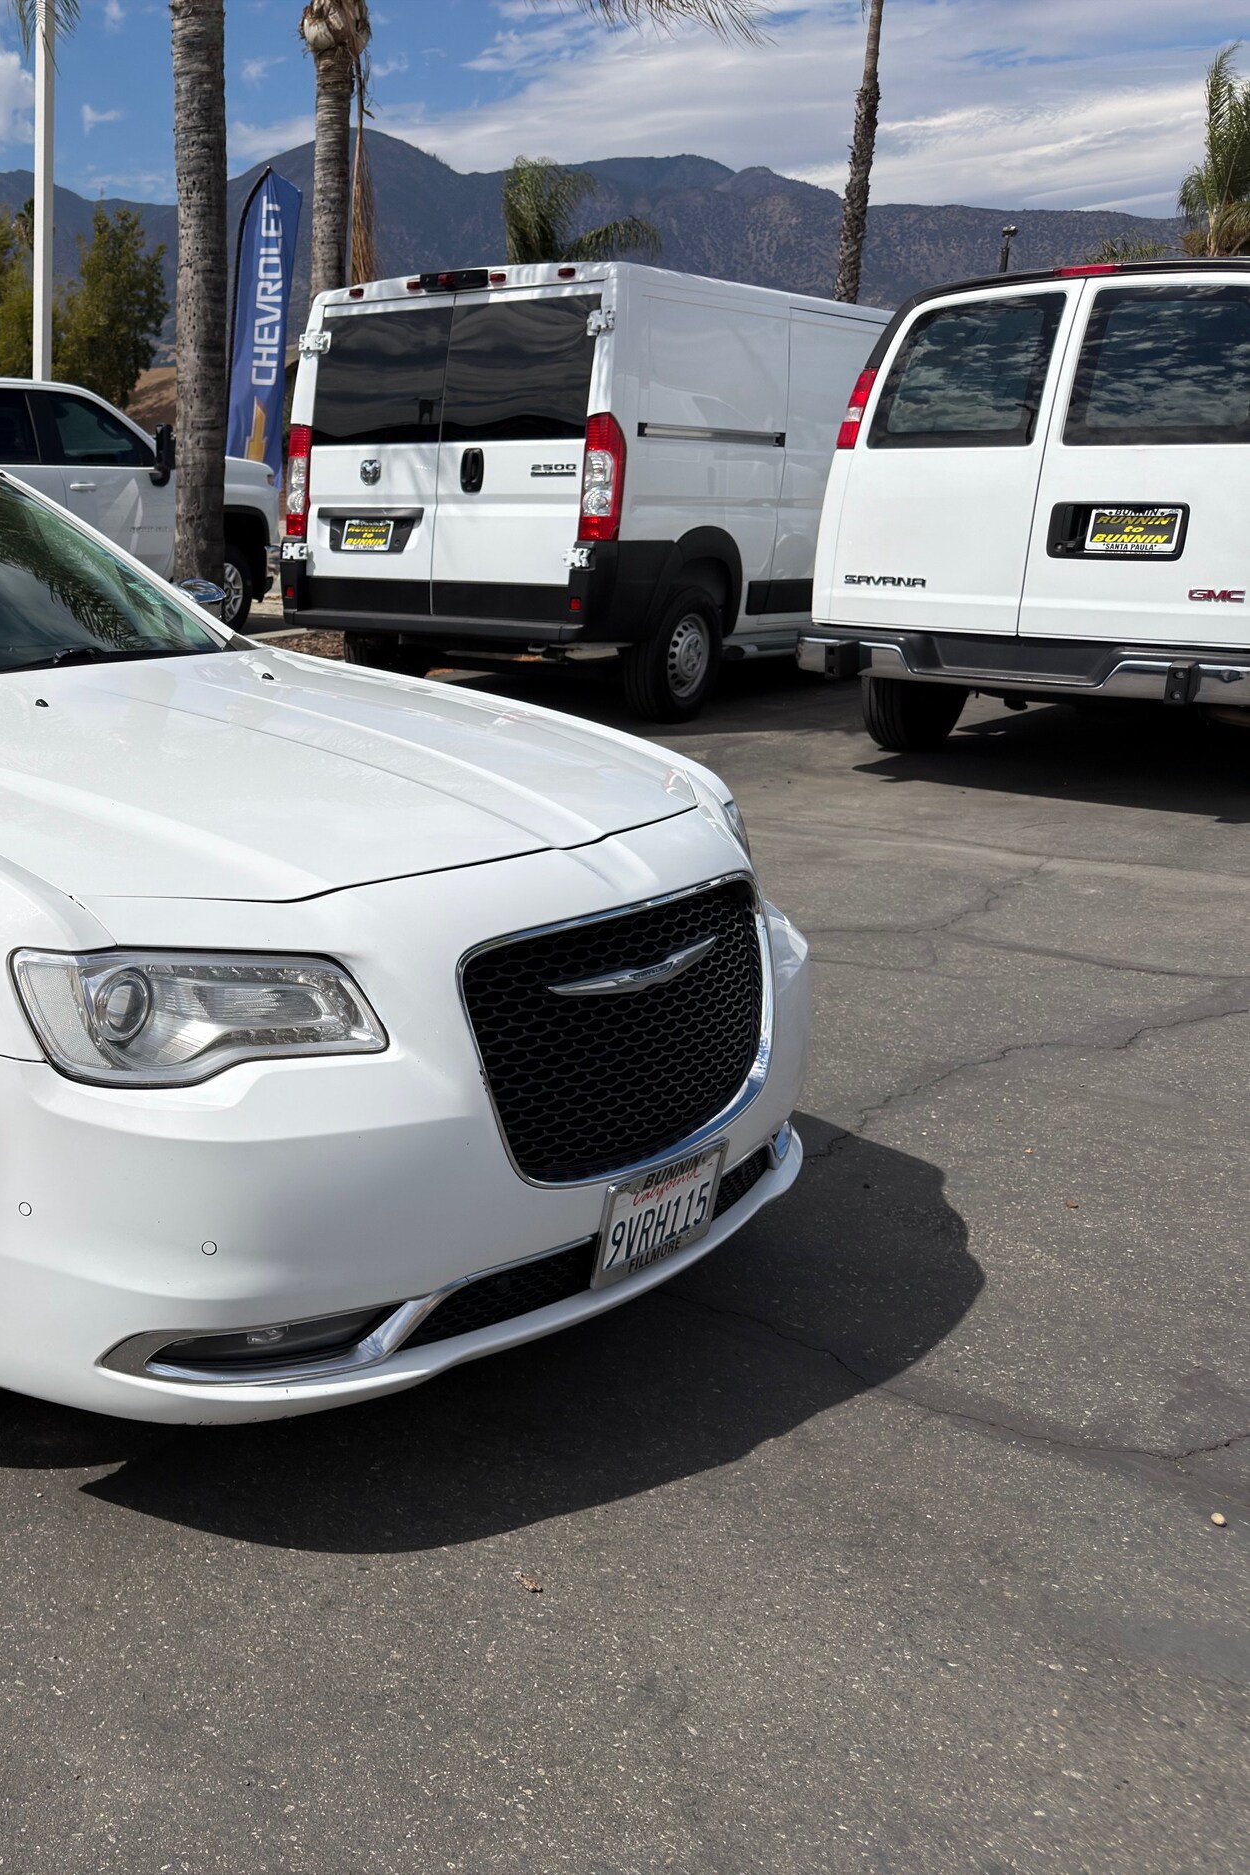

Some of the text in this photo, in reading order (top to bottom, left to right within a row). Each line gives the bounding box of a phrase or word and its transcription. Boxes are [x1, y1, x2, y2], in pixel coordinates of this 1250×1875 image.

[251, 195, 283, 386] CHEVROLET
[1091, 533, 1169, 544] BUNNIN
[1123, 525, 1145, 533] to
[345, 538, 387, 546] BUNNIN
[844, 575, 927, 588] SAVANA
[1188, 589, 1246, 603] GMC
[642, 1152, 703, 1190] BUNNIN
[633, 1168, 701, 1207] California
[605, 1181, 710, 1269] 9VRH115
[628, 1236, 682, 1273] FILLMORE
